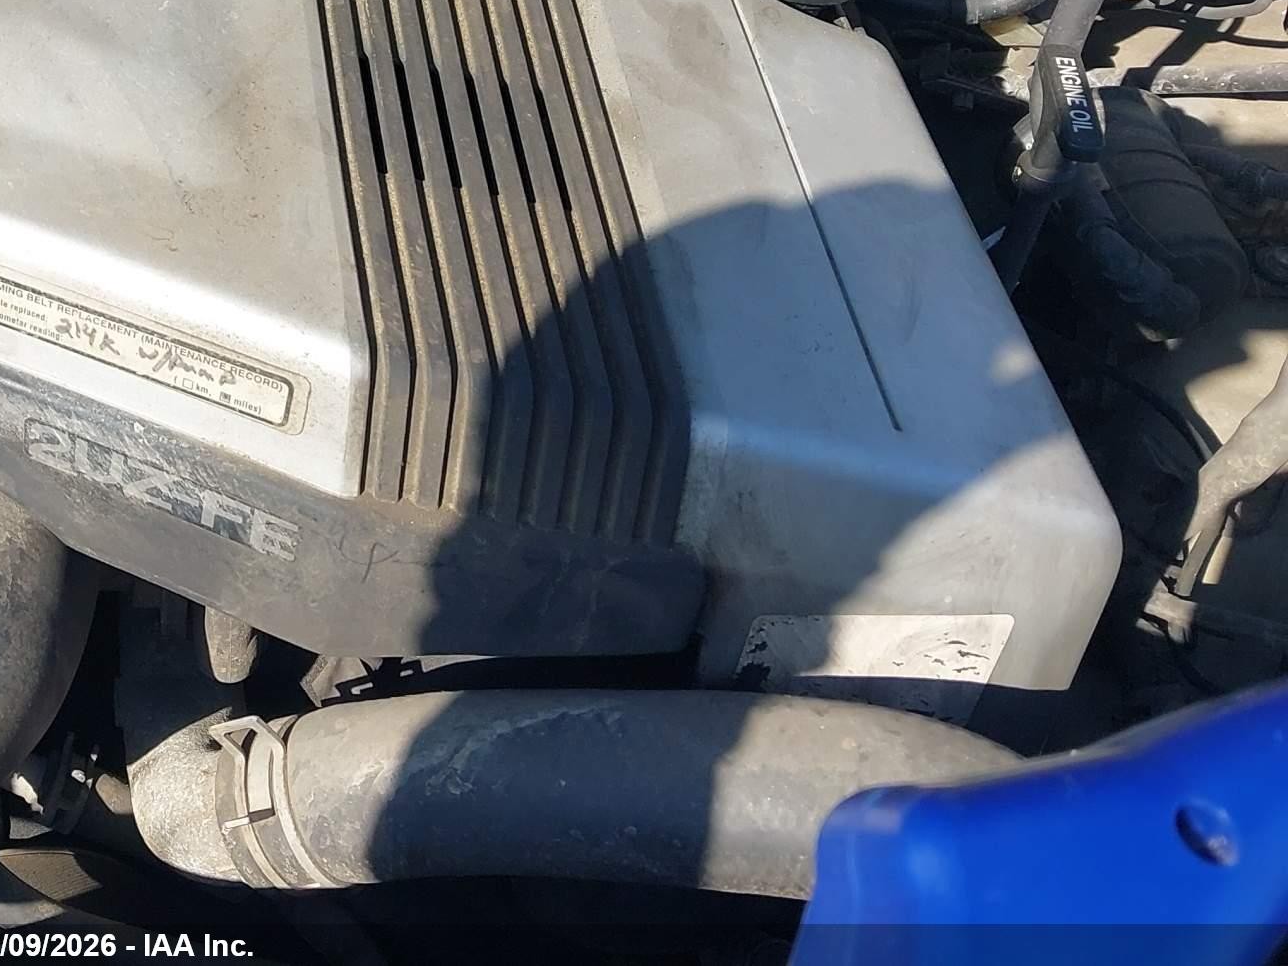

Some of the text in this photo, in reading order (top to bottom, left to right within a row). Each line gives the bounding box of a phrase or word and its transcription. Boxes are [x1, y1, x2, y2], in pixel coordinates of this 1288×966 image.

[1055, 57, 1094, 132] ENGINE OIL
[26, 293, 53, 309] BELT
[57, 304, 138, 339] REPLACEMENT
[141, 334, 227, 371] (MAINTENANCE
[231, 366, 283, 393] RECORD)
[233, 397, 262, 414] miles)
[25, 418, 302, 562] 2UZ-FE
